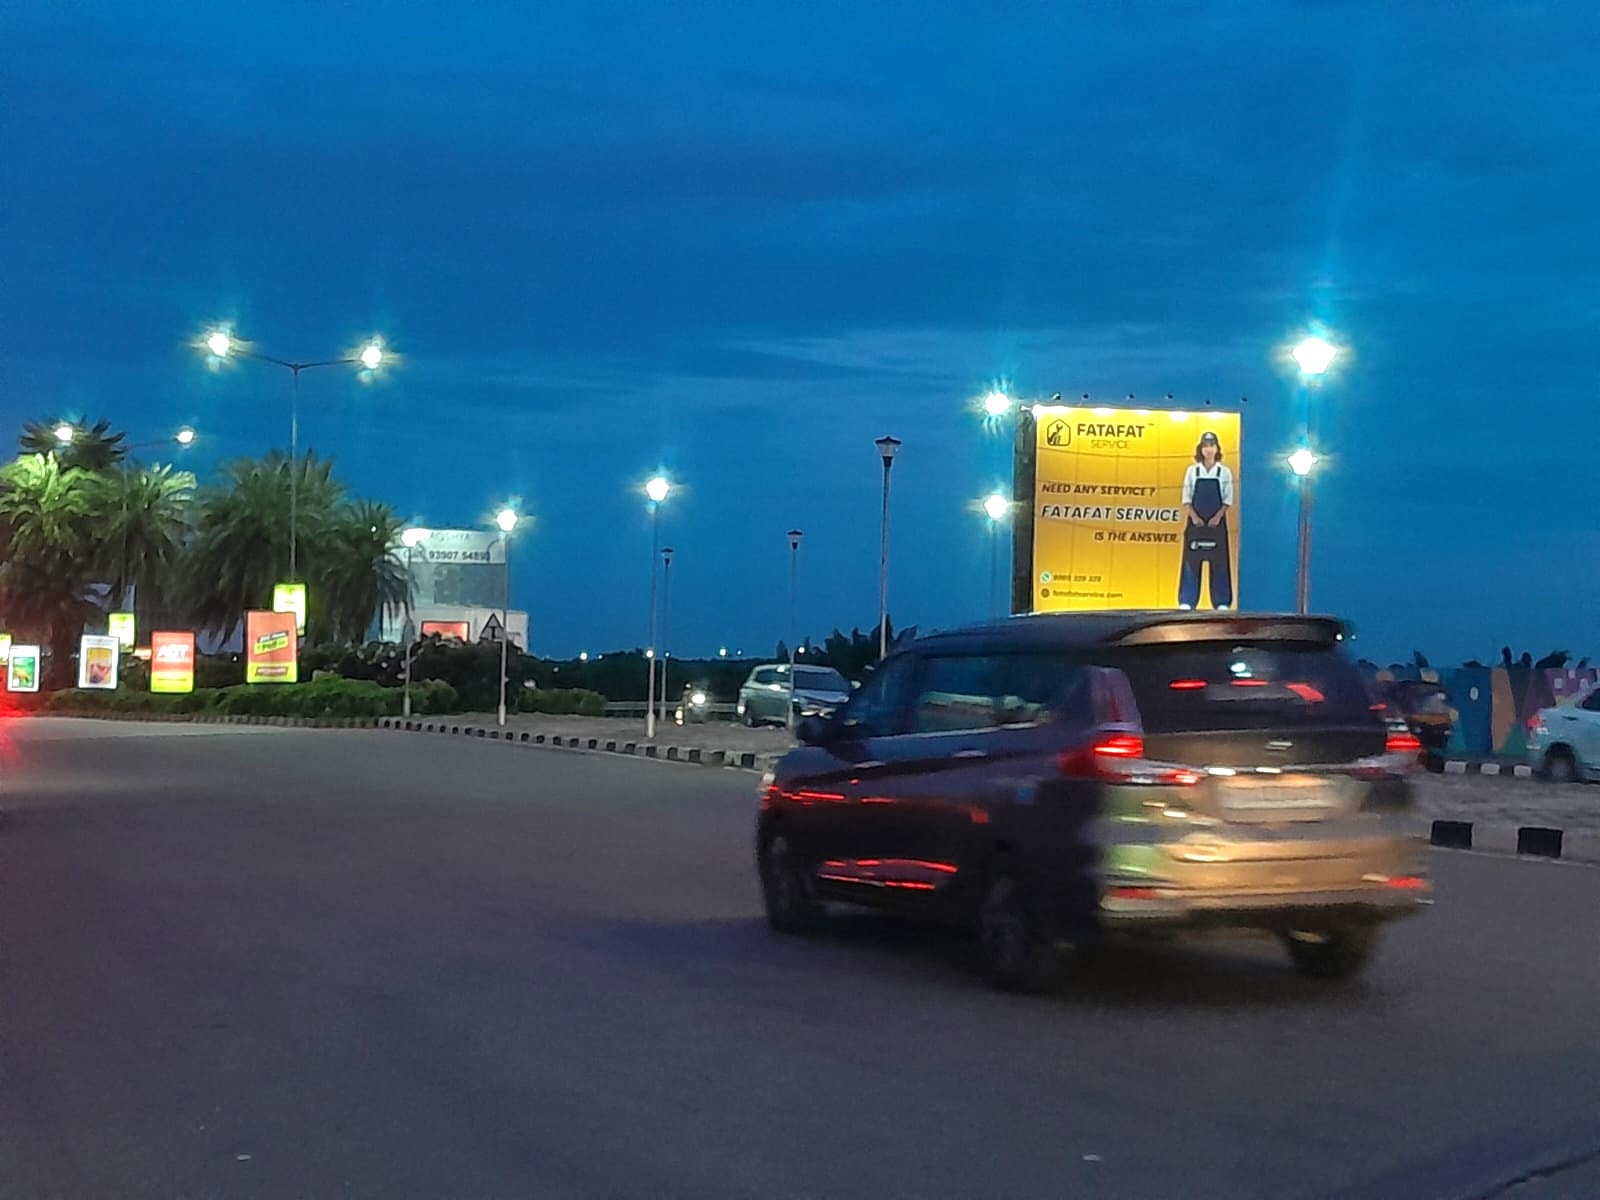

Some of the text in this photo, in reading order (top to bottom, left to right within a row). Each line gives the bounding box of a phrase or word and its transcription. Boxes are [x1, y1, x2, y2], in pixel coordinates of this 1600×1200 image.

[1077, 423, 1145, 438] FATAFAT
[1090, 439, 1129, 449] SERVICE
[1041, 483, 1071, 493] NEED
[1074, 484, 1097, 494] ANY
[1100, 485, 1146, 495] SERVICE
[1041, 505, 1180, 522] FATAFAT SERVICE
[1094, 532, 1105, 541] IS
[1107, 532, 1126, 542] THE
